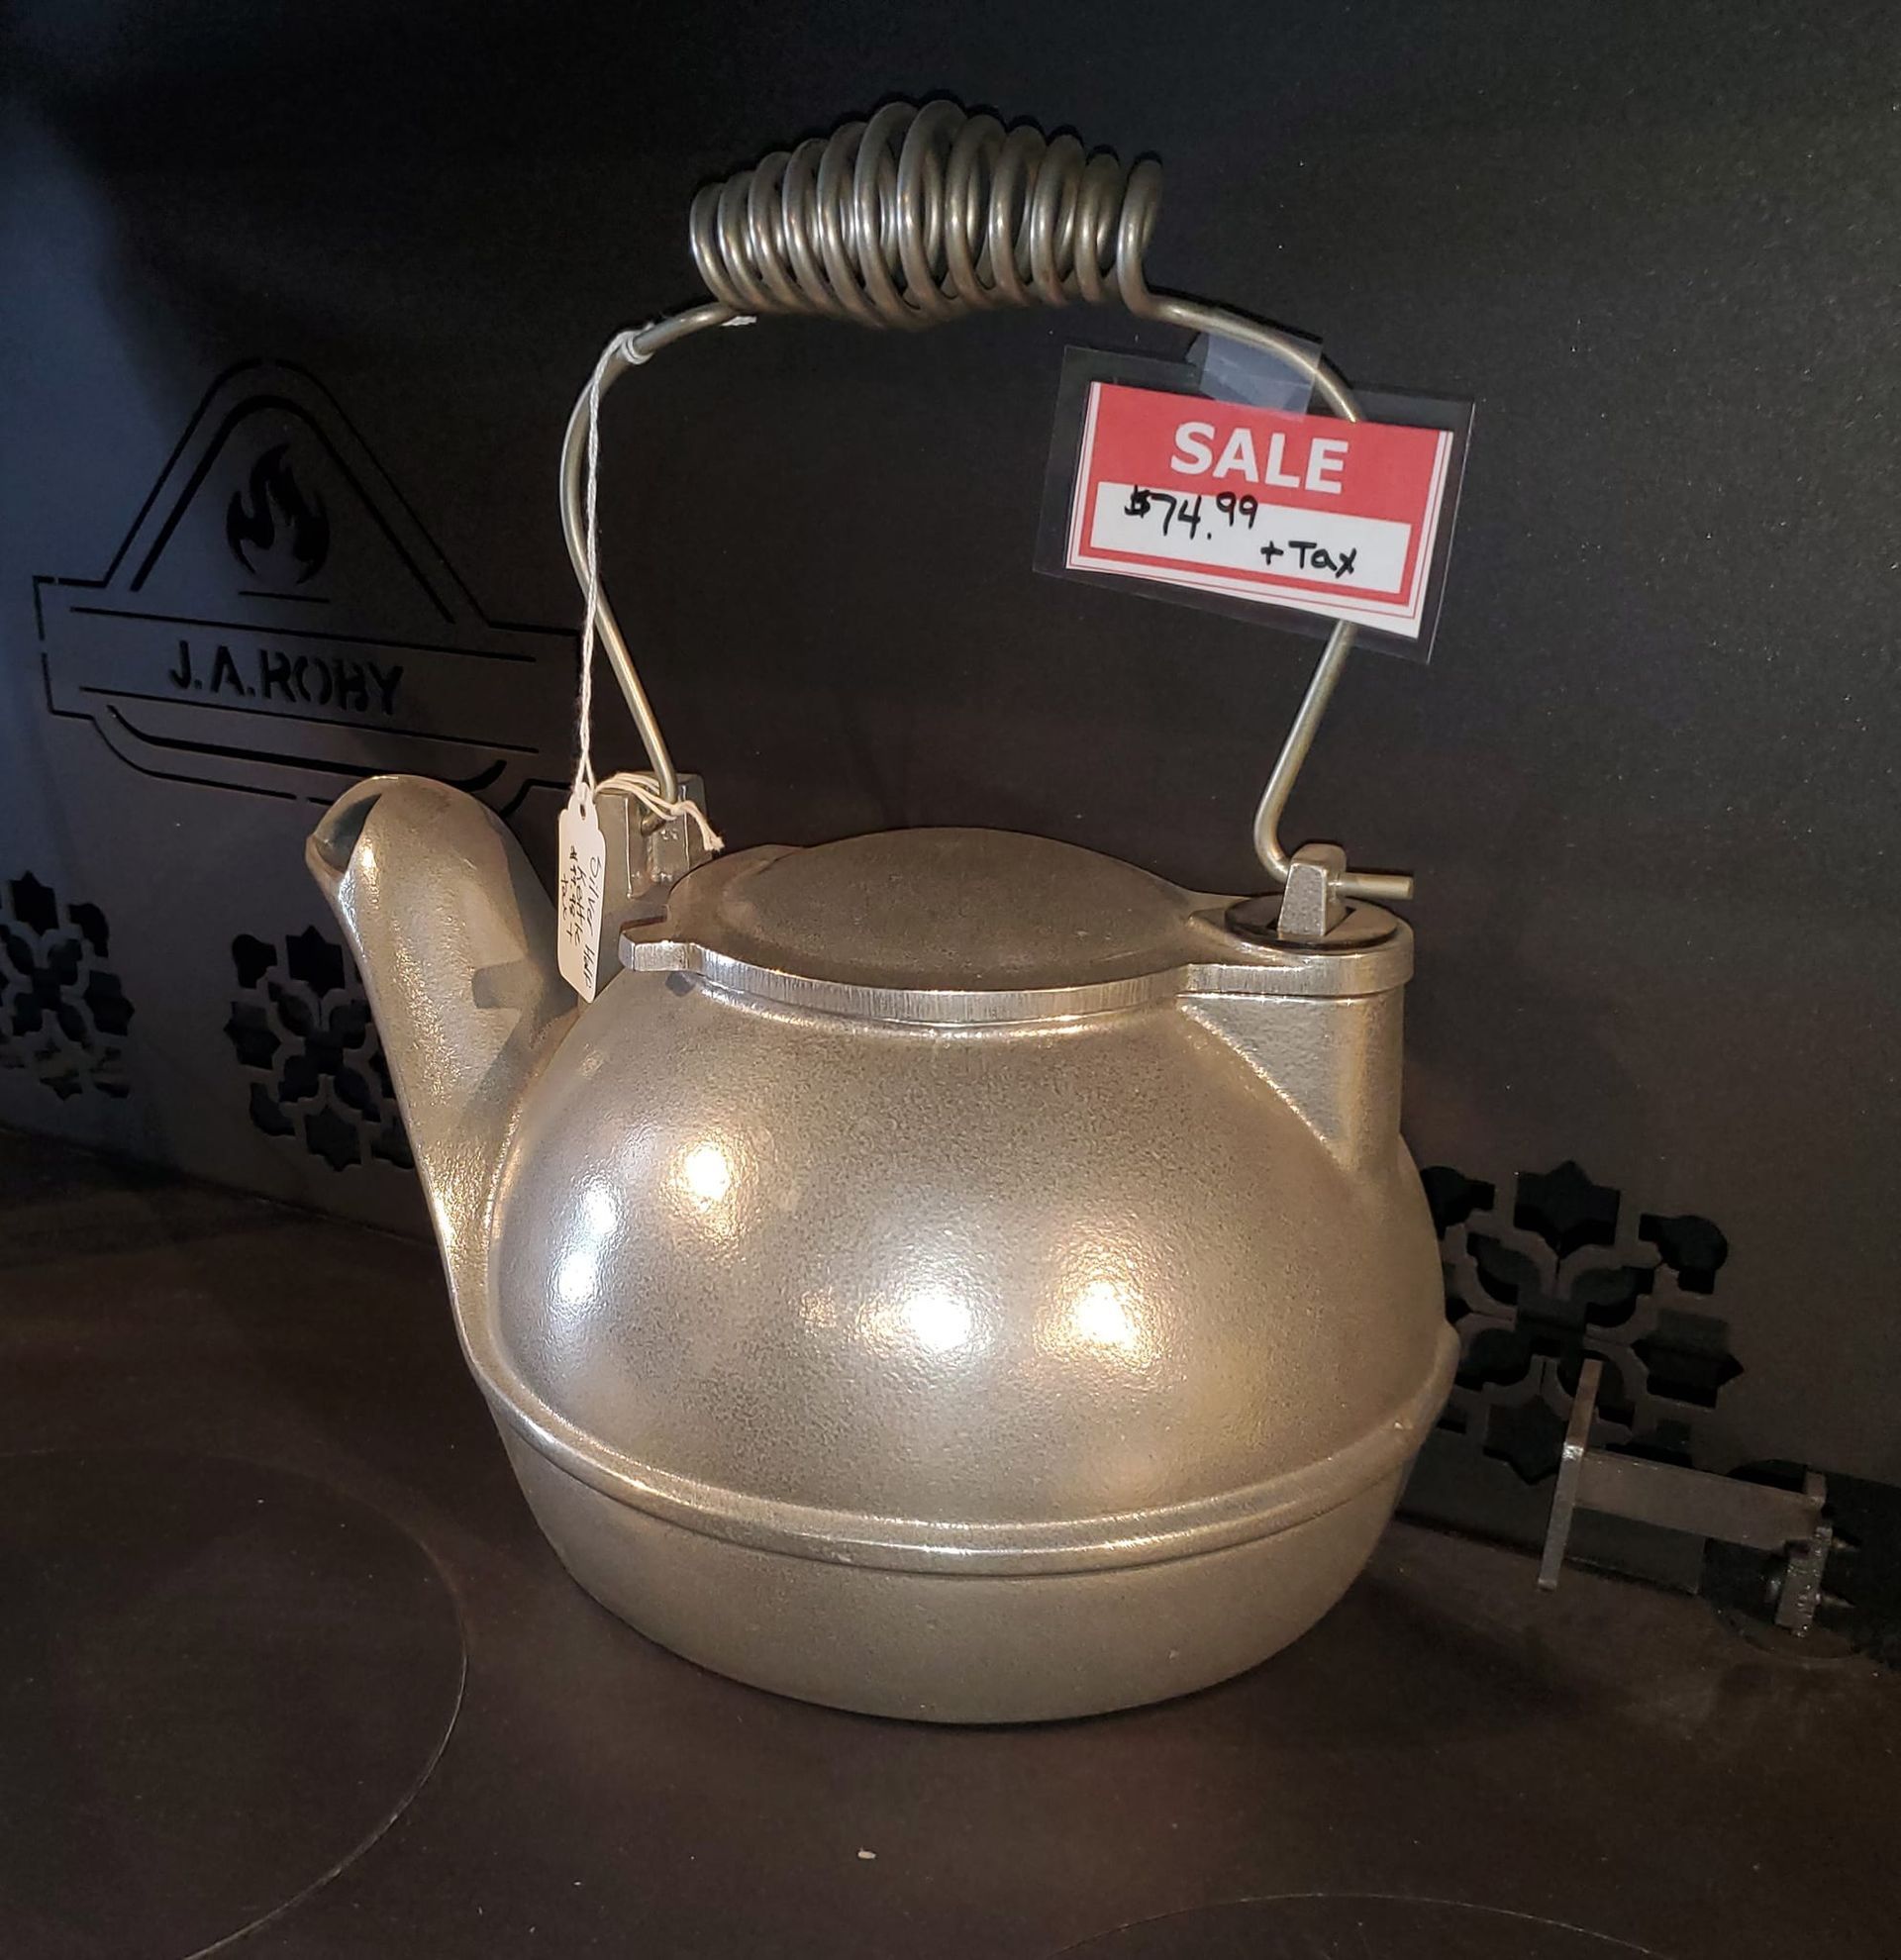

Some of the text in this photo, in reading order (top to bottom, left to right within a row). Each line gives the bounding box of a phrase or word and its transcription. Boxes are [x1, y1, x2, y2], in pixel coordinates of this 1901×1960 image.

[1170, 422, 1349, 494] SALE
[1124, 485, 1258, 540] $74.99
[574, 865, 587, 946] Kettle
[587, 855, 602, 936] Silver
